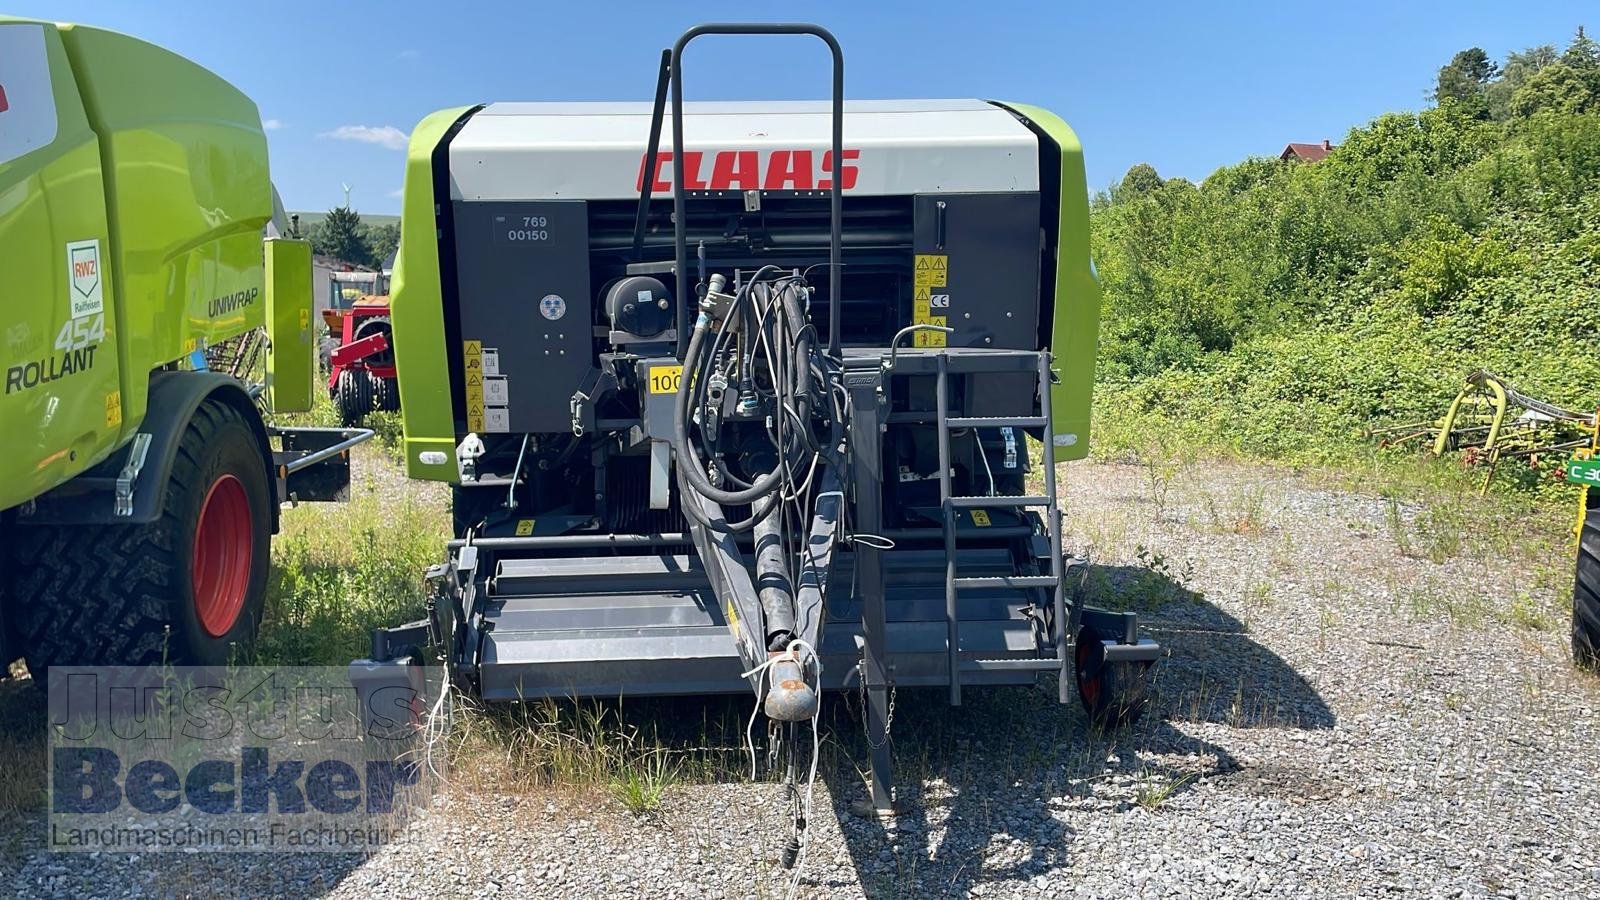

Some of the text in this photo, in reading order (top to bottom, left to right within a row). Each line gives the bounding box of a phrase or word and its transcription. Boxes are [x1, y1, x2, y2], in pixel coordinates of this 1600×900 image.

[635, 150, 860, 192] CLAAS
[523, 216, 547, 227] 769
[508, 230, 548, 241] 00150
[75, 260, 96, 278] RWZ
[208, 287, 258, 318] UNIWRAP
[931, 295, 948, 307] CE
[54, 311, 105, 352] 454
[5, 344, 98, 395] ROLLANT
[1571, 465, 1582, 478] C
